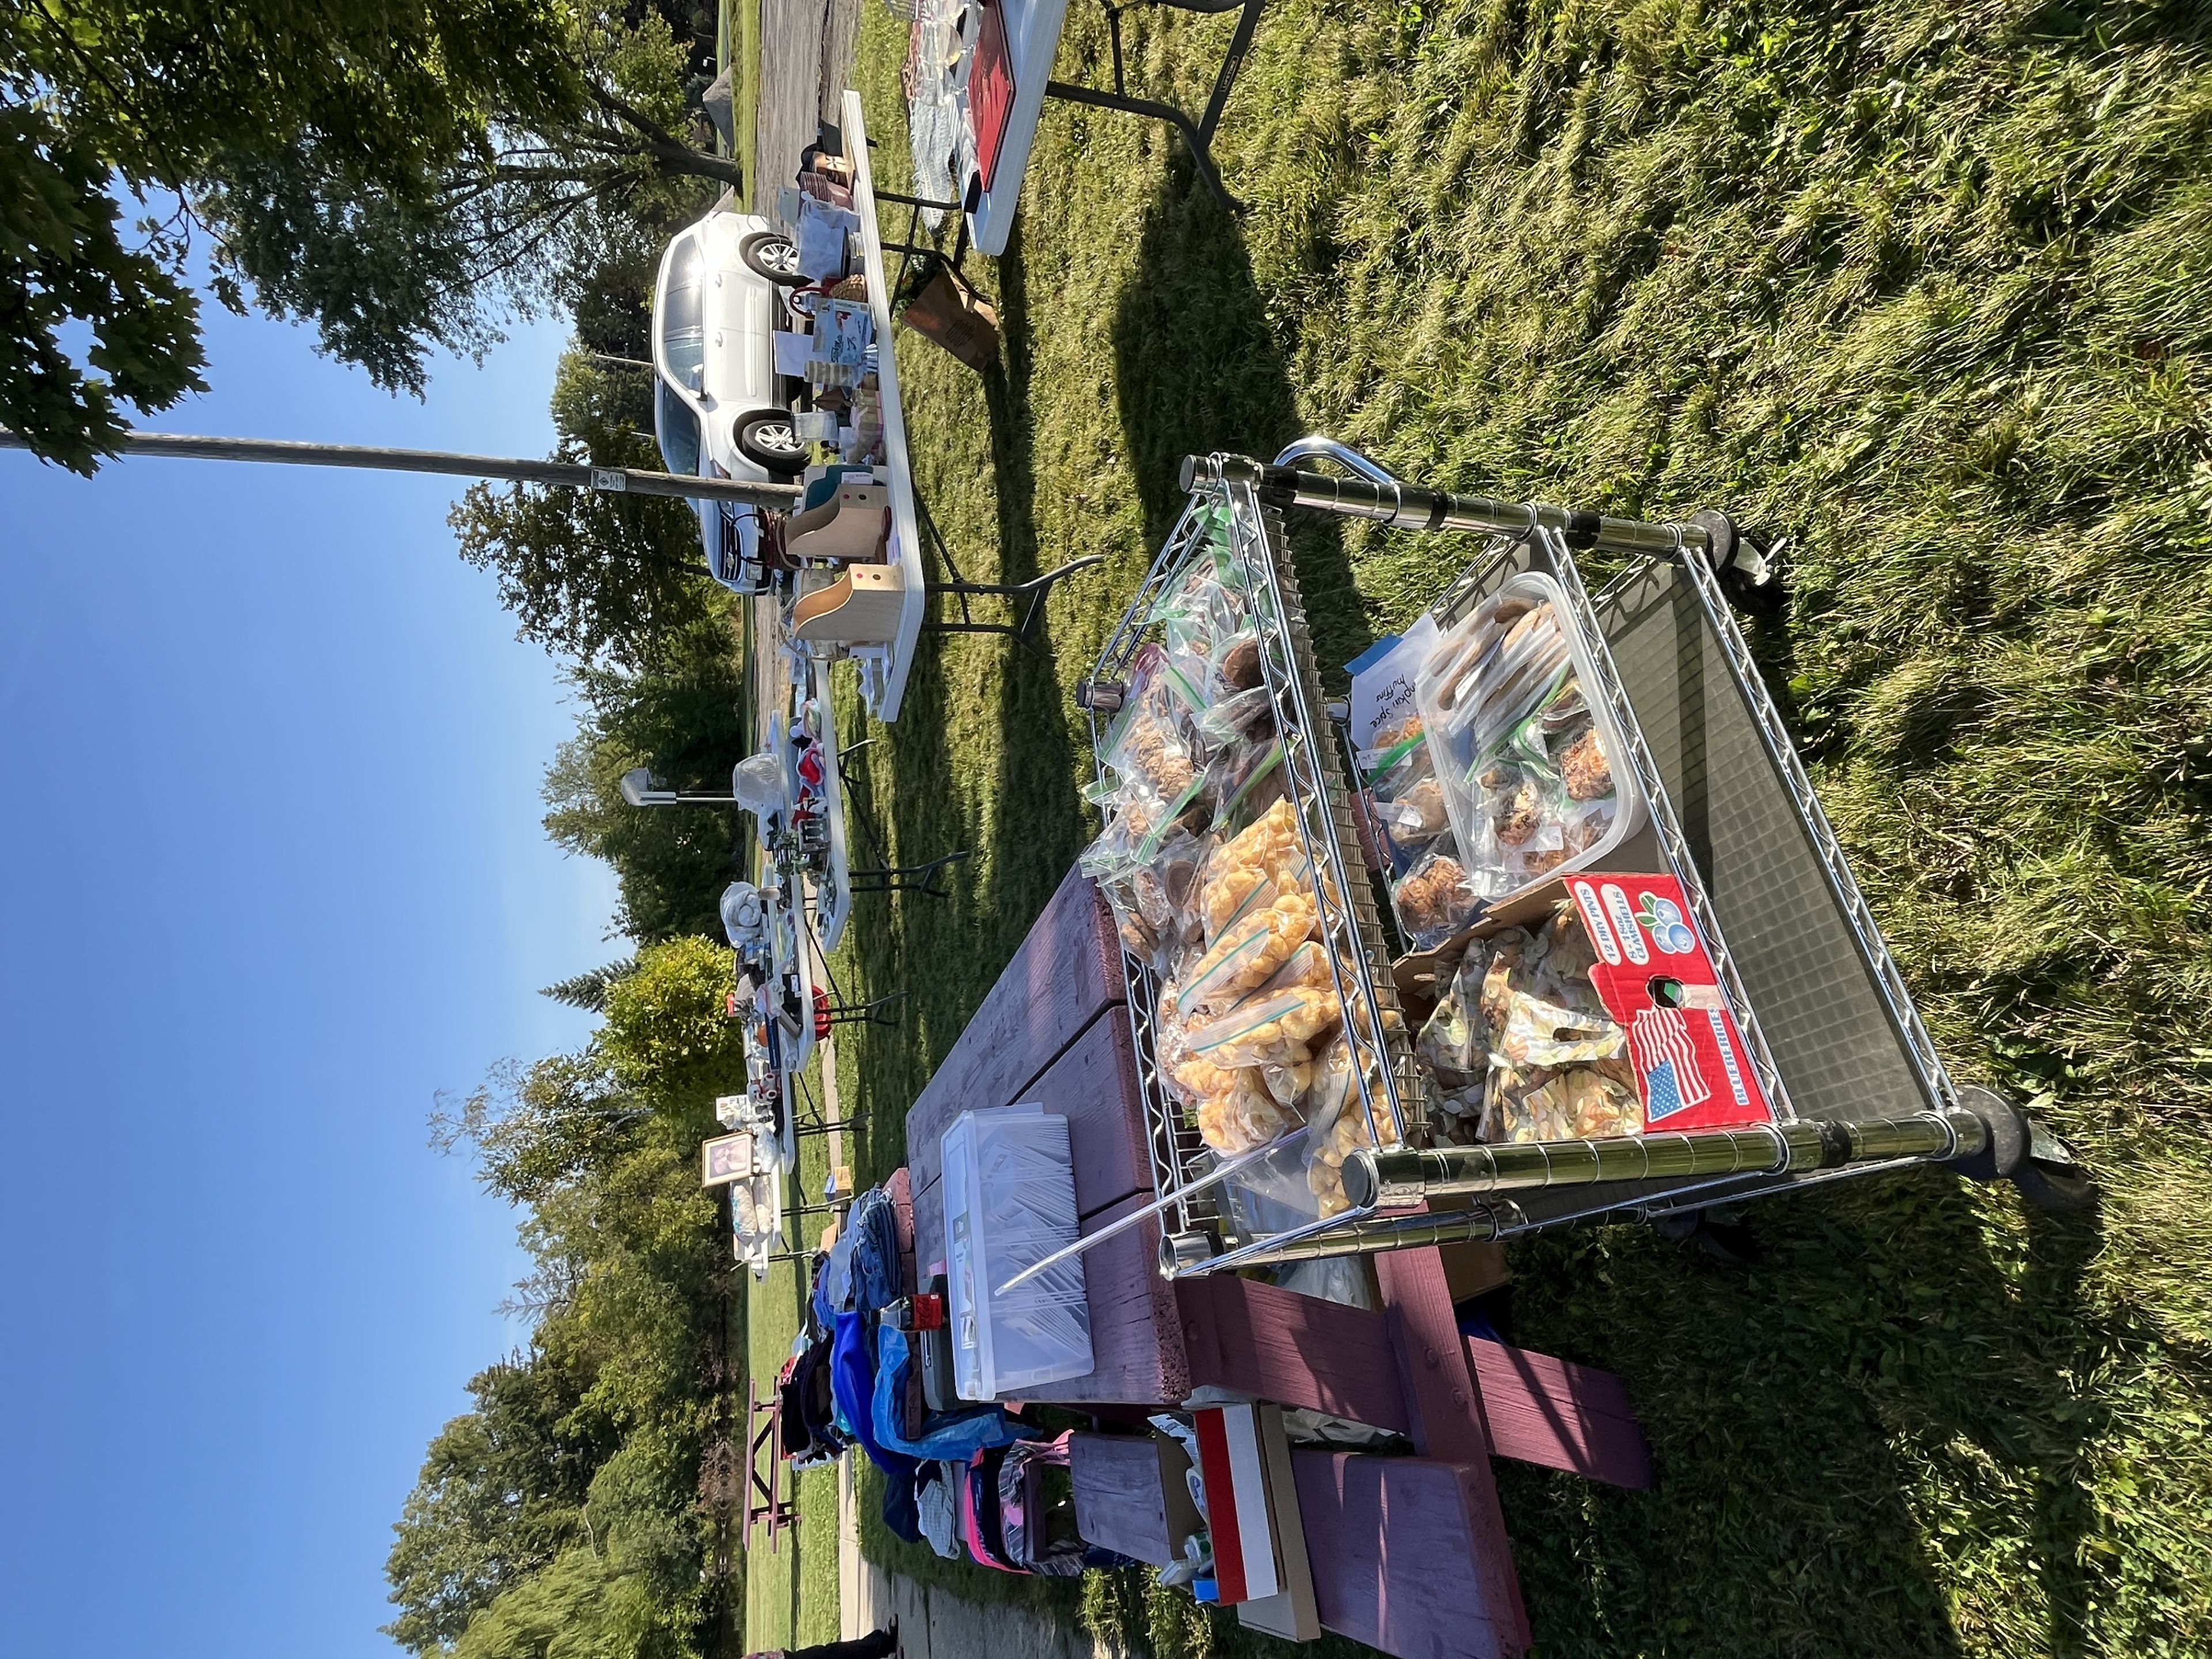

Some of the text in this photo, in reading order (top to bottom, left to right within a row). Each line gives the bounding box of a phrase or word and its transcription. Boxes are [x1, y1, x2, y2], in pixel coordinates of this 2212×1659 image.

[1392, 682, 1416, 709] mpkin
[1580, 889, 1616, 959] 12 DRY PINTS
[1612, 891, 1647, 959] CLAMSHELLS
[1615, 915, 1630, 941] 18oz
[1628, 951, 1638, 959] 8
[1708, 1006, 1748, 1104] BLUEBERRIES
